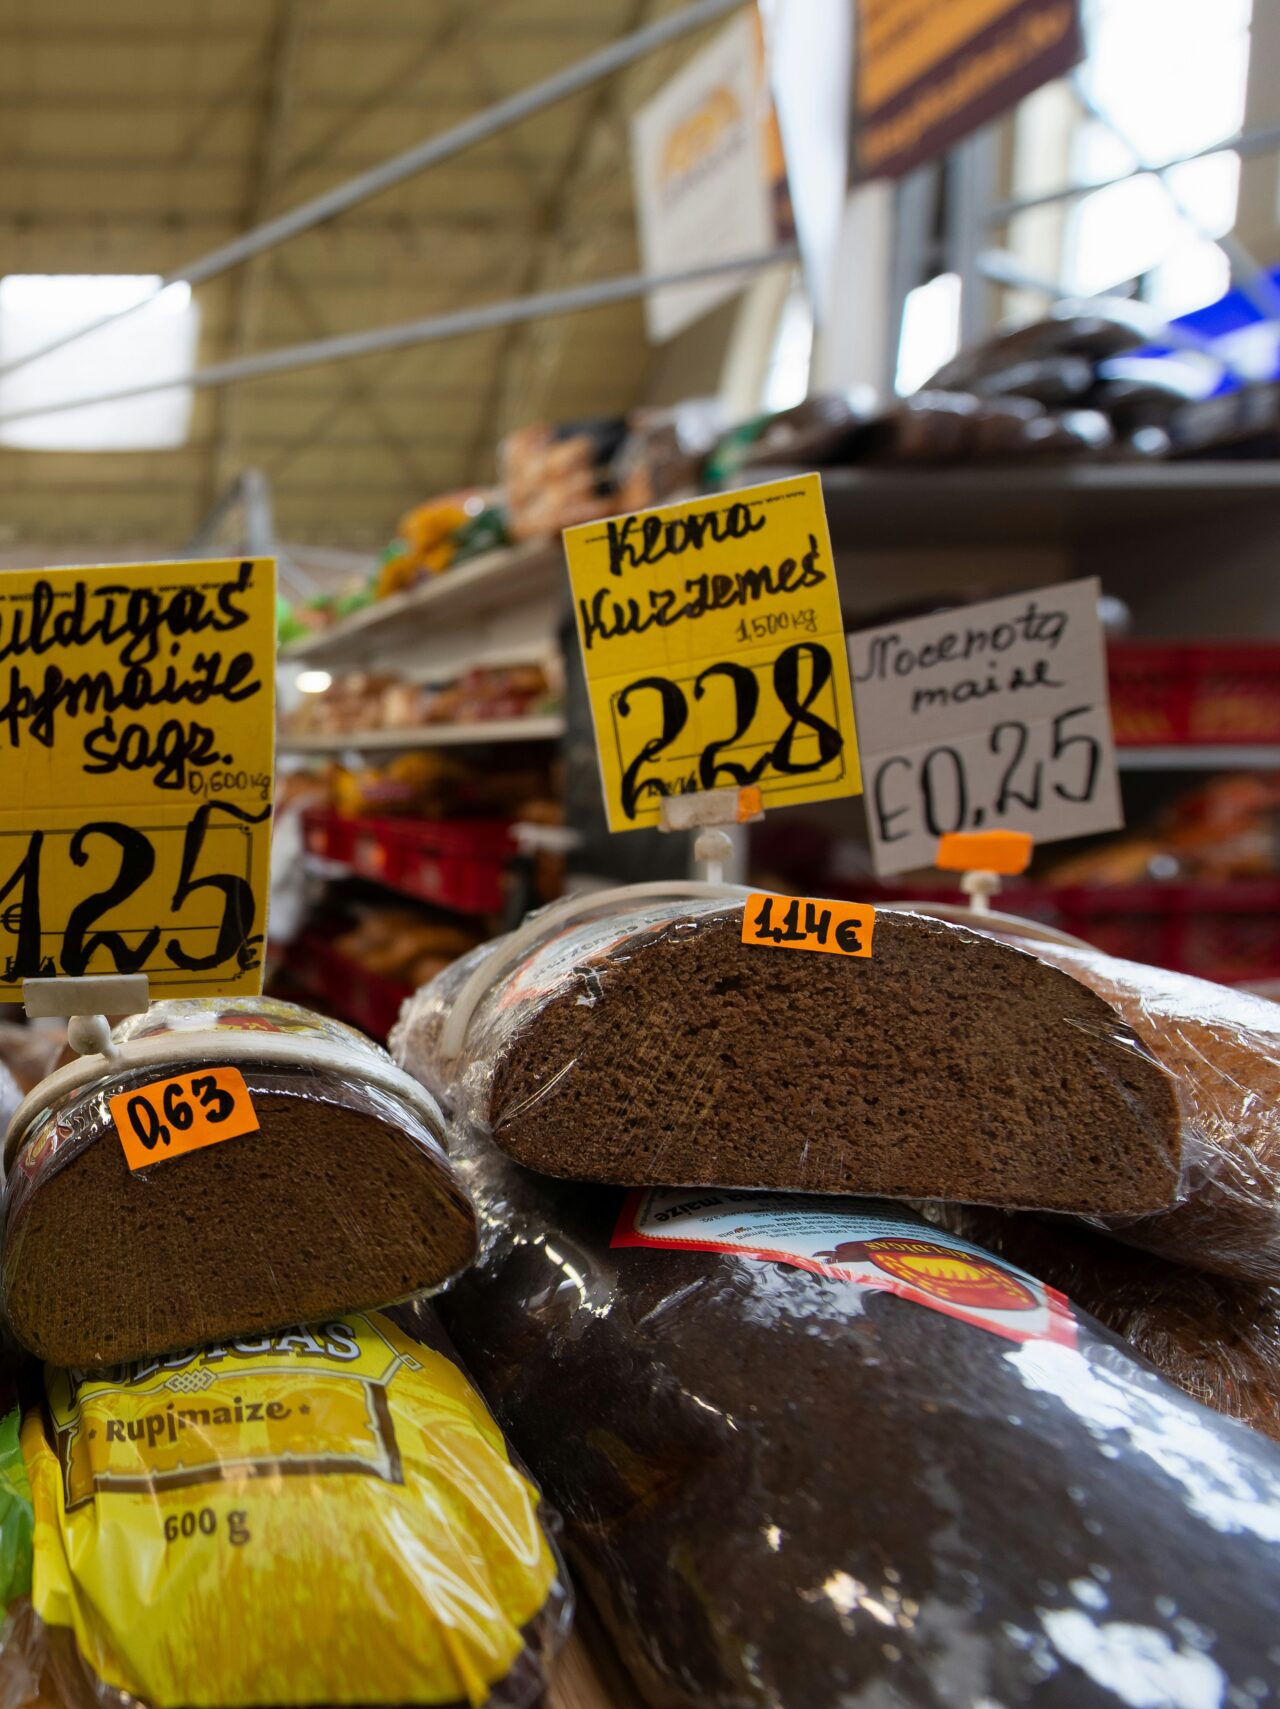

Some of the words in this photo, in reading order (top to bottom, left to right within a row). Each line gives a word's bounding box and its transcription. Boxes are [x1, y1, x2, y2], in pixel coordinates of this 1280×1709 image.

[911, 659, 1064, 714] maize
[127, 1075, 235, 1150] 0,63
[106, 1396, 291, 1448] Rupjmaize
[163, 1506, 217, 1544] 600
[226, 1509, 251, 1546] g
